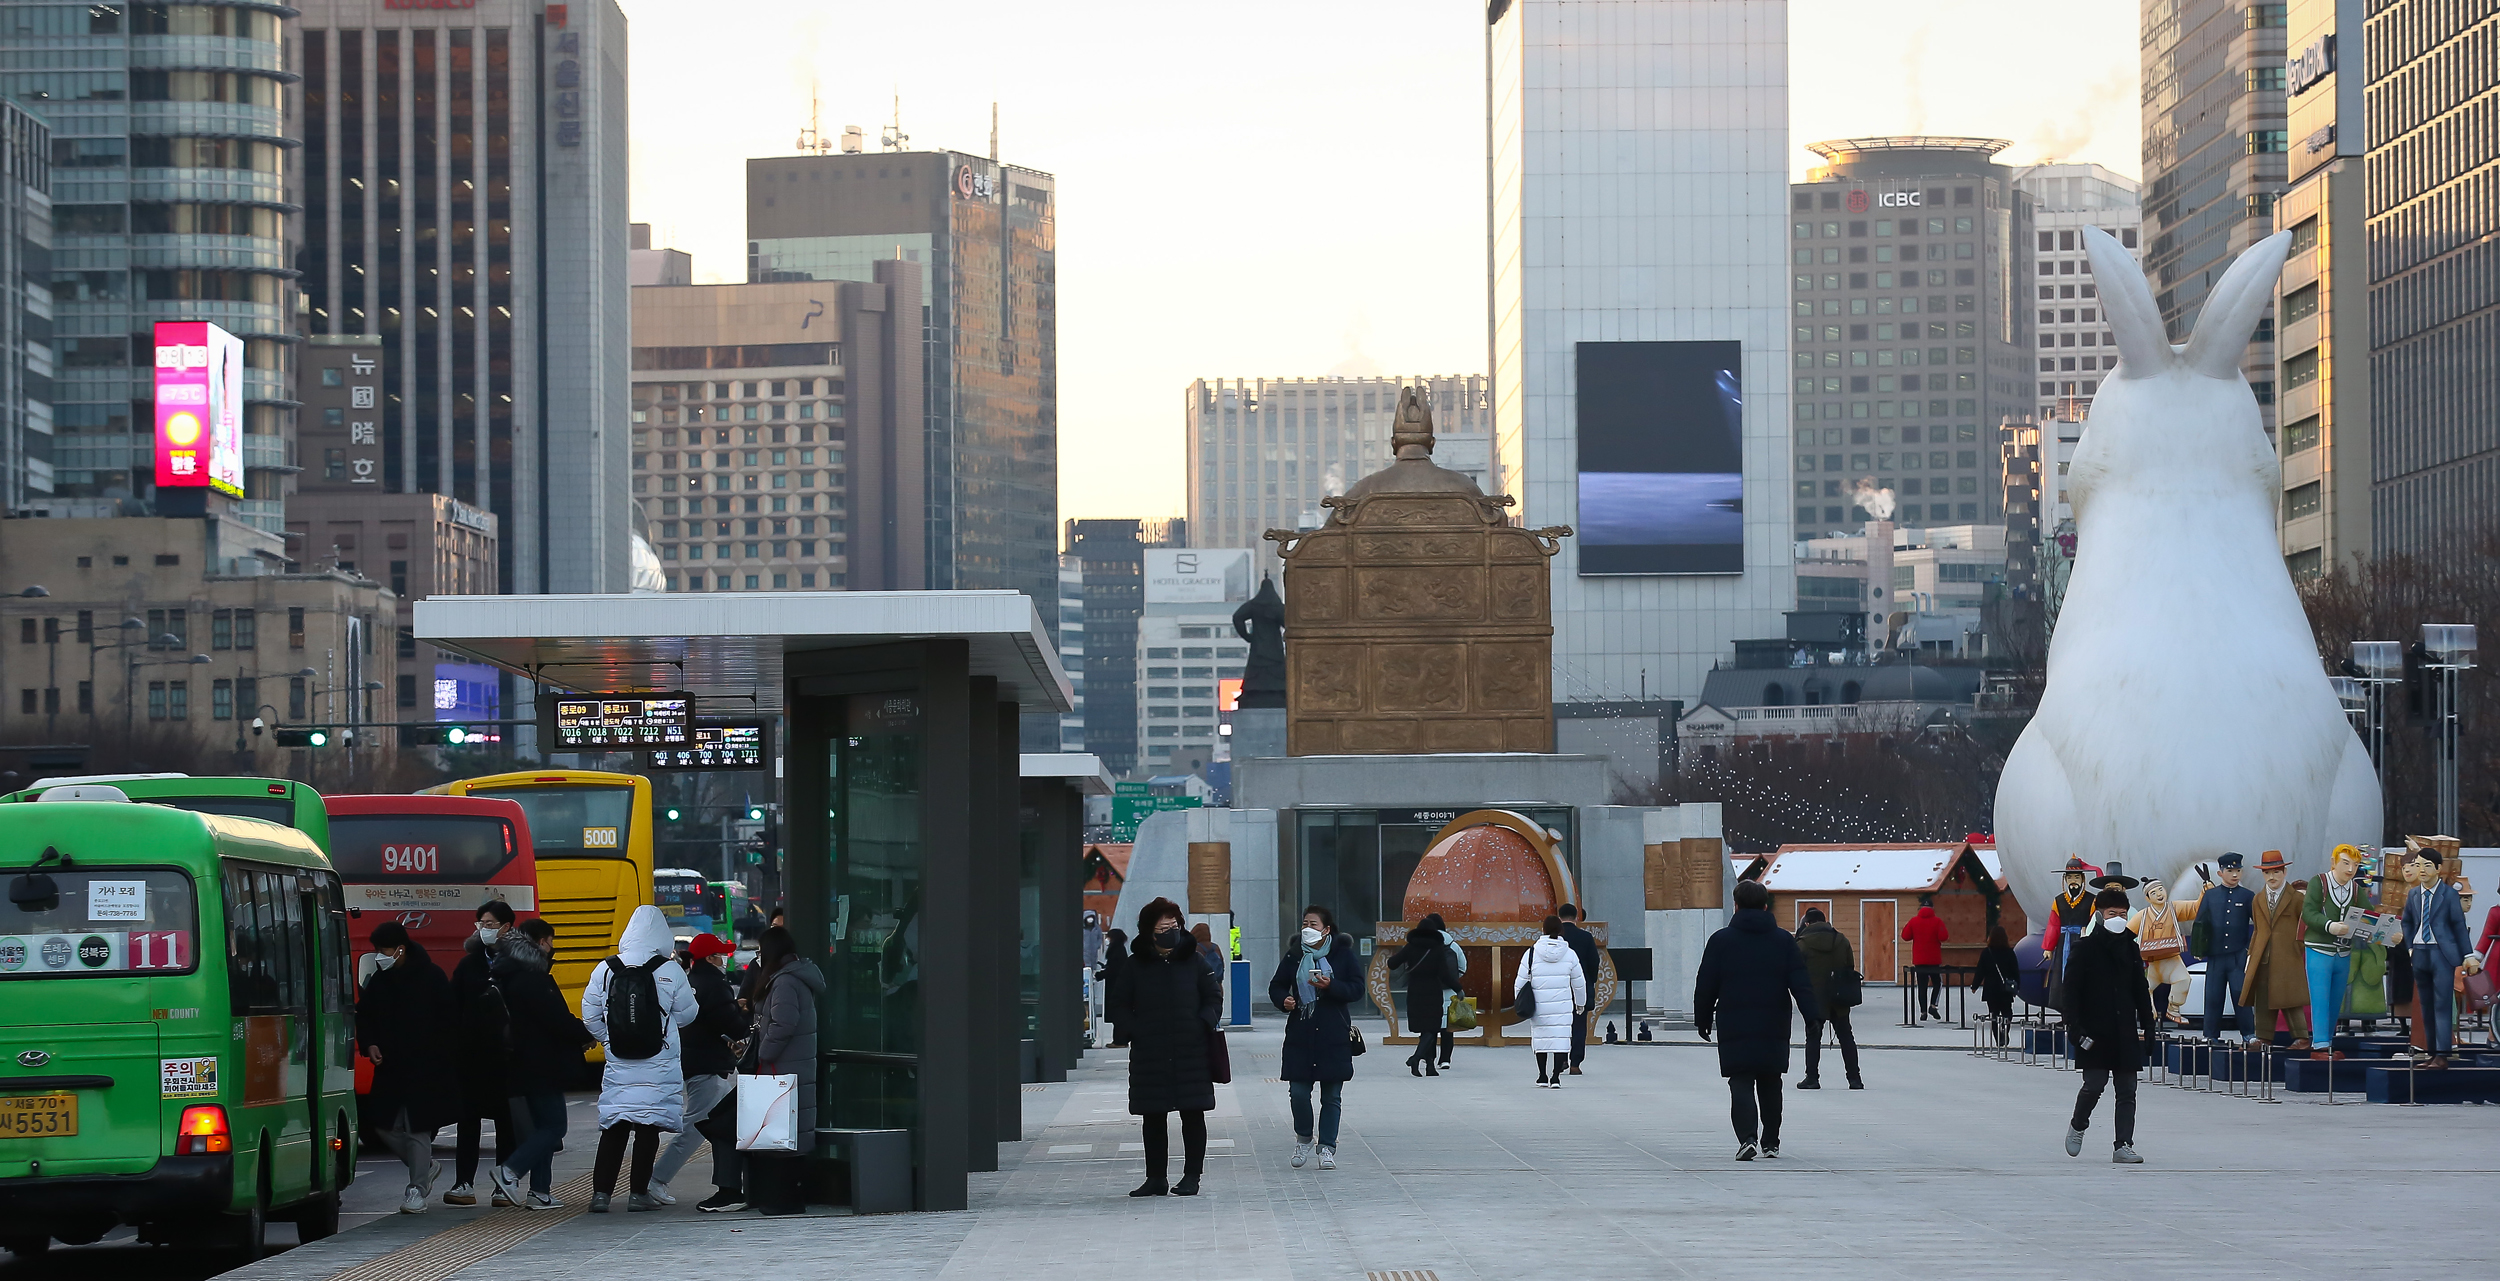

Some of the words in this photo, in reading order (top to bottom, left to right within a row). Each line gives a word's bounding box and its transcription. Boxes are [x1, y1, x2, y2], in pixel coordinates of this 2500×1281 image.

[1878, 192, 1920, 207] ICBC
[1182, 577, 1222, 585] GRACERY
[561, 705, 587, 715] 종로09
[603, 704, 630, 715] 종로11
[561, 728, 581, 737] 7016
[587, 728, 607, 736] 7018
[613, 727, 633, 736] 7022
[639, 726, 659, 735] 7212
[667, 726, 682, 735] N51
[695, 732, 711, 740] 로11
[655, 752, 668, 760] 401
[677, 751, 690, 759] 406
[699, 751, 712, 759] 700
[721, 750, 734, 758] 704
[741, 750, 758, 758] 1711
[1413, 811, 1455, 820] 세종이야기
[584, 828, 616, 846] 5000
[384, 846, 438, 872] 9401
[98, 886, 116, 896] 기사
[118, 886, 136, 896] 모집
[365, 888, 387, 899] 육아는
[389, 888, 413, 899] 나누고,
[416, 888, 437, 899] 행복은
[439, 888, 461, 898] 더하고
[42, 943, 71, 953] 프레스
[79, 947, 110, 958] 경복궁
[134, 932, 182, 968] 11
[47, 954, 66, 964] 센터
[152, 1008, 168, 1019] NEW
[169, 1008, 199, 1019] COUNTY
[163, 1061, 194, 1077] 주의
[163, 1076, 196, 1086] 우회전시
[14, 1098, 35, 1110] 서울
[38, 1097, 57, 1109] 70
[16, 1110, 70, 1133] 5531
